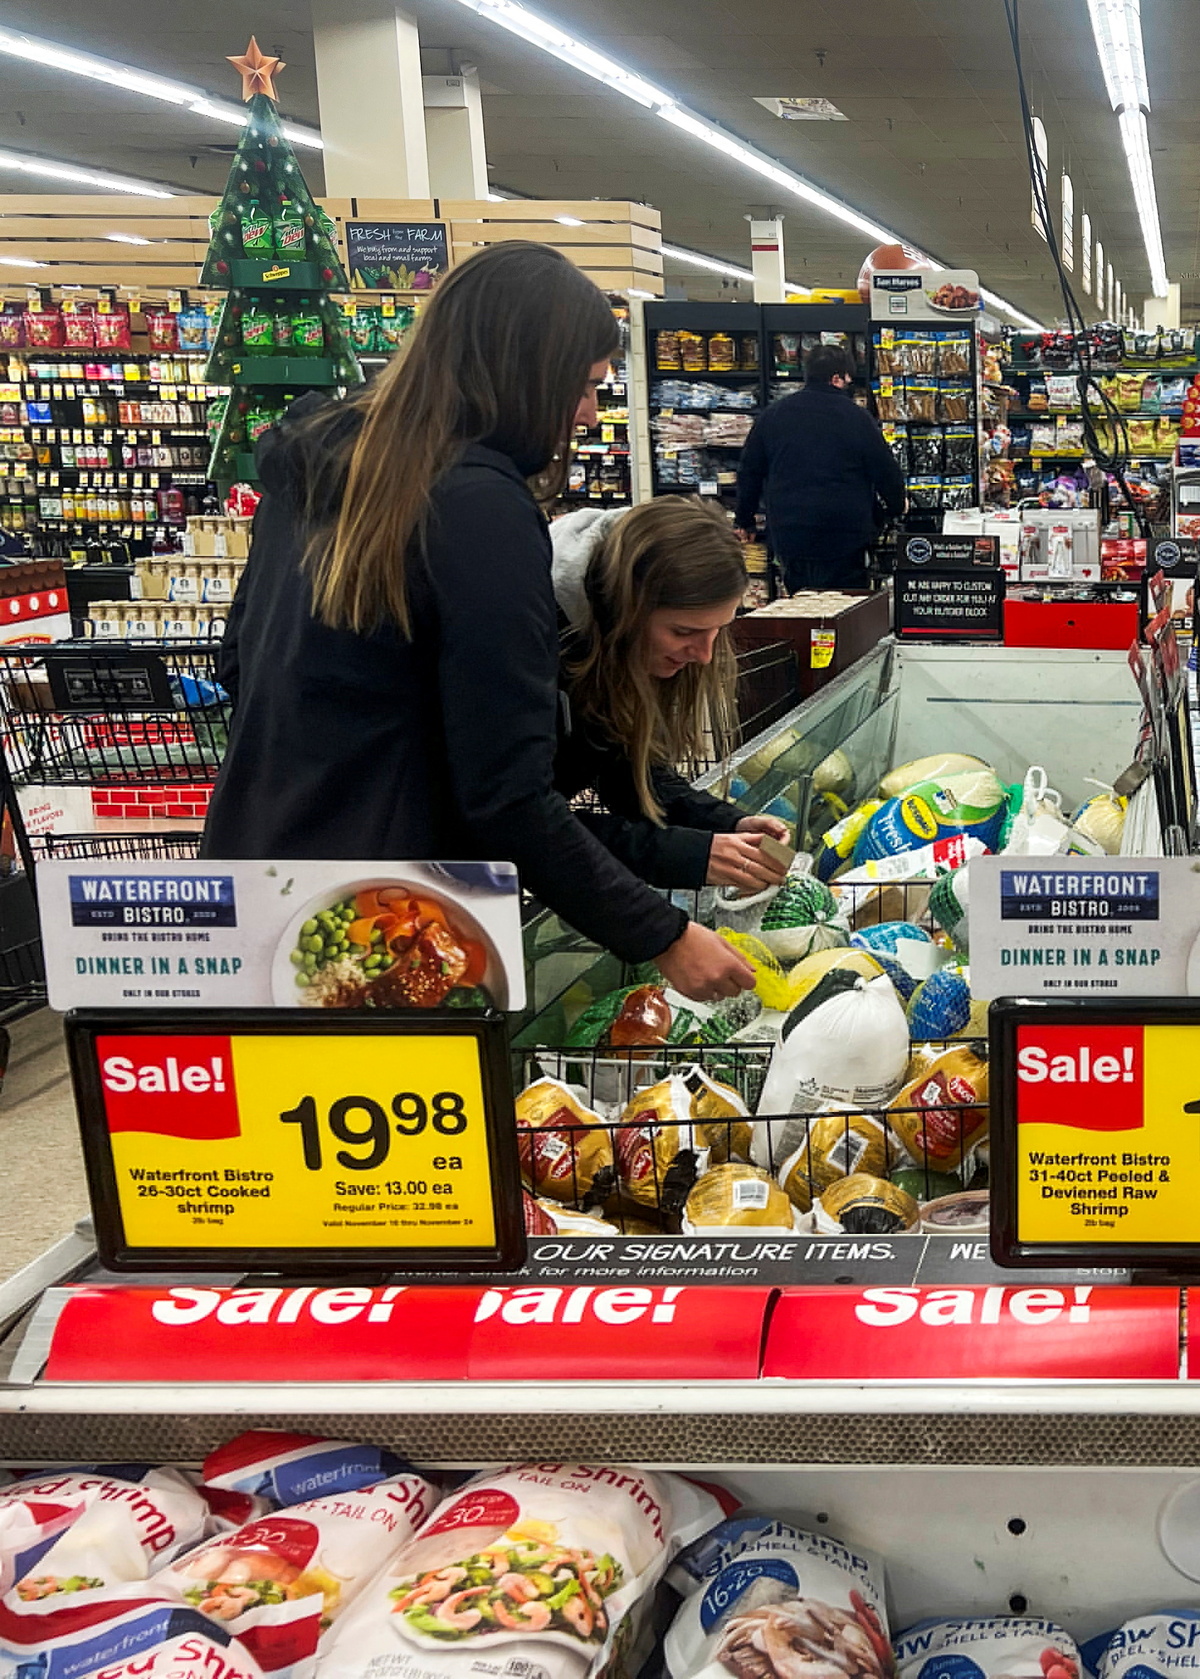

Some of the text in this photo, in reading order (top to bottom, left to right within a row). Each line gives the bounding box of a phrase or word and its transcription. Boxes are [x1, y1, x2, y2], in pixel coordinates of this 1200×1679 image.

[350, 228, 442, 241] FRESH FARM
[381, 245, 398, 253] from
[399, 245, 412, 253] and
[412, 247, 438, 255] support
[264, 268, 290, 279] Schweppes
[82, 880, 223, 901] WATERFRONT
[1013, 875, 1148, 896] WATERFRONT
[123, 907, 185, 923] BISTRO
[1051, 901, 1109, 917] BISTRO
[102, 932, 210, 942] BRING THE BISTRO HOME
[1028, 925, 1132, 934] BRING THE BISTRO HOME
[1001, 949, 1161, 966] DINNER IN A SNAP
[76, 957, 242, 975] DINNER IN A SNAP
[1043, 980, 1062, 988] ONLY
[1074, 980, 1089, 988] OUR
[1090, 980, 1118, 988] STORES
[123, 989, 142, 998] ONLY
[172, 989, 201, 998] STORES
[1018, 1046, 1134, 1084] Sale!
[103, 1056, 227, 1094] Sale!
[433, 1154, 463, 1171] ea
[1029, 1152, 1171, 1166] Waterfront Bistro
[129, 1168, 274, 1183] Waterfront Bistro
[1028, 1169, 1171, 1183] 31-40ct Peeled &
[137, 1184, 271, 1198] 26-30ct Cooked
[335, 1181, 453, 1197] Save: 13.00 ea
[1041, 1186, 1158, 1200] Deviened Raw
[177, 1200, 235, 1216] shrimp
[333, 1203, 375, 1214] Regular
[378, 1202, 409, 1212] Price:
[1070, 1203, 1129, 1218] Shrimp
[322, 1219, 342, 1227] Valid
[345, 1219, 387, 1227] November
[534, 1242, 897, 1262] OUR SIGNATURE ITEMS.
[948, 1243, 988, 1260] WE
[538, 1266, 564, 1277] for
[573, 1267, 631, 1277] more
[637, 1265, 760, 1277] information
[152, 1286, 408, 1325] Sale!
[855, 1286, 1092, 1326] Sale!
[290, 1460, 381, 1496] waterfront
[517, 1472, 591, 1493] TAIL ON
[328, 1502, 398, 1532] TAIL ON
[705, 1565, 765, 1615] 16-20
[63, 1619, 171, 1676] waterfront
